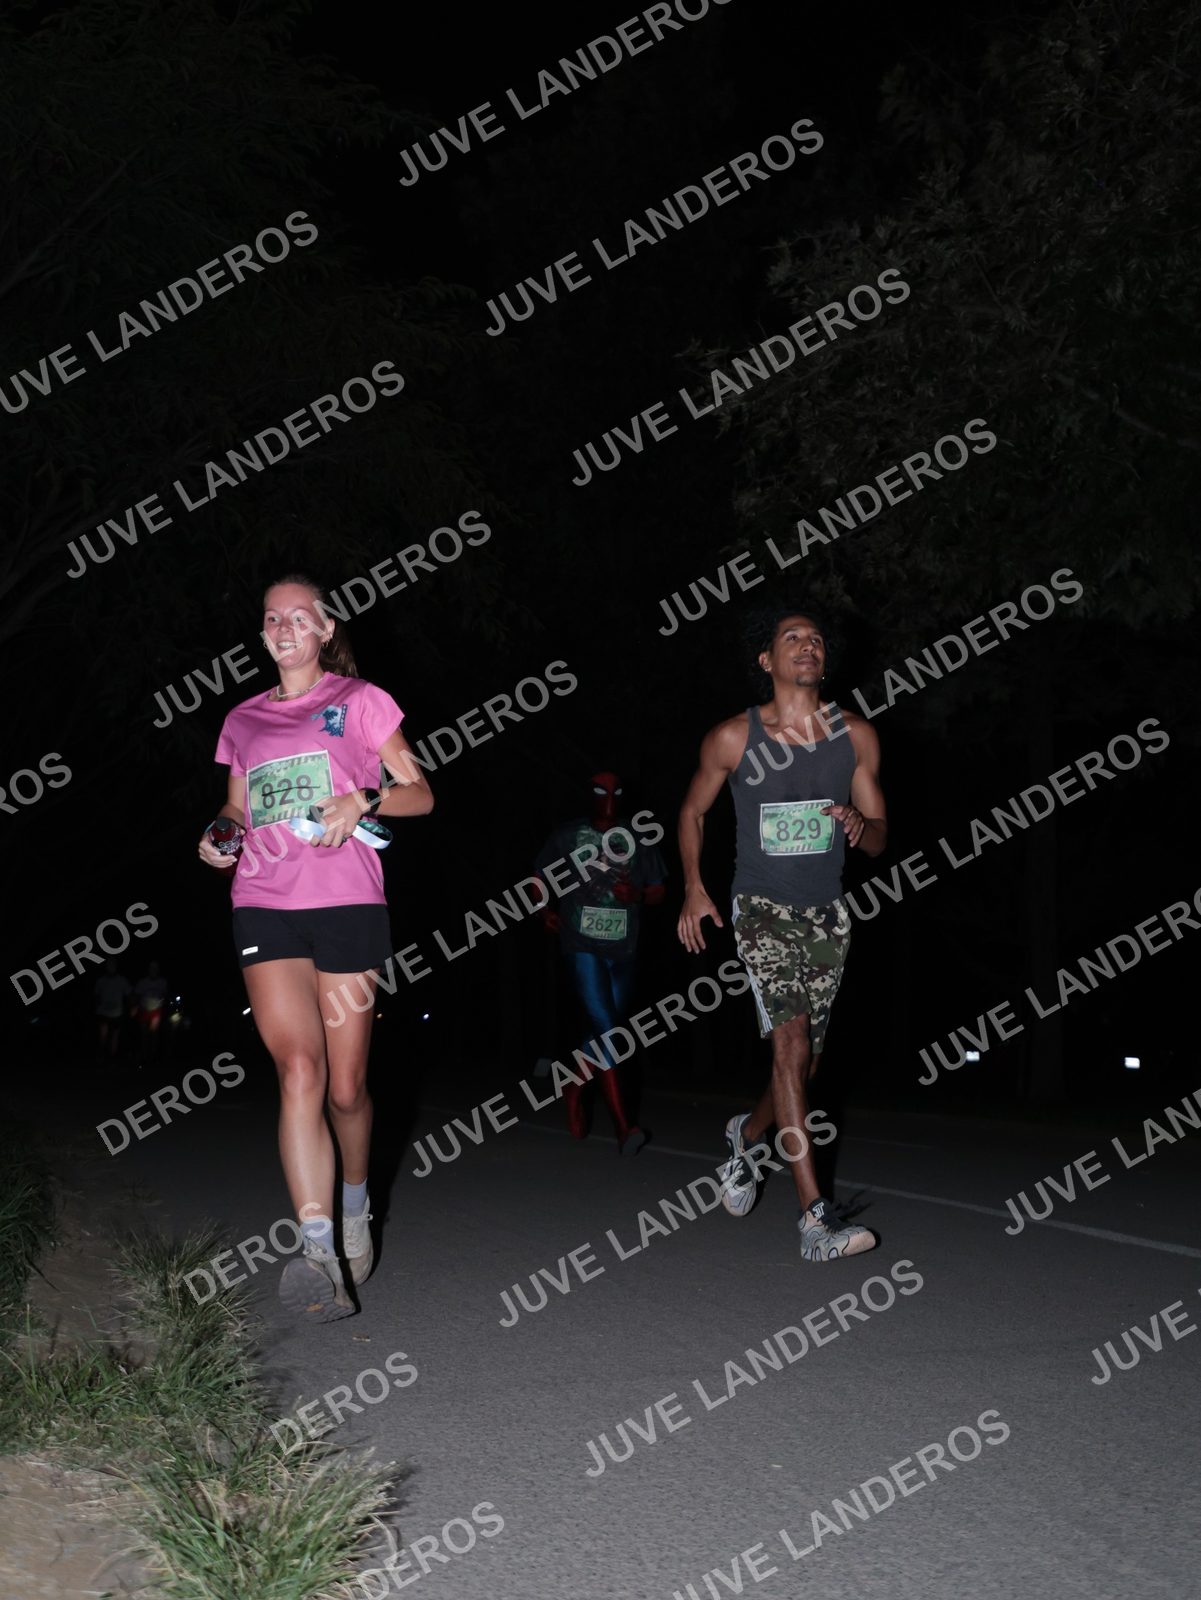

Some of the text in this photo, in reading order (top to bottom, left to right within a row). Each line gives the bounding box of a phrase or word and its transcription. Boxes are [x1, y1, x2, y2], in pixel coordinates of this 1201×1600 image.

[262, 775, 313, 809] 828
[776, 818, 821, 842] 829
[586, 917, 622, 932] 2627
